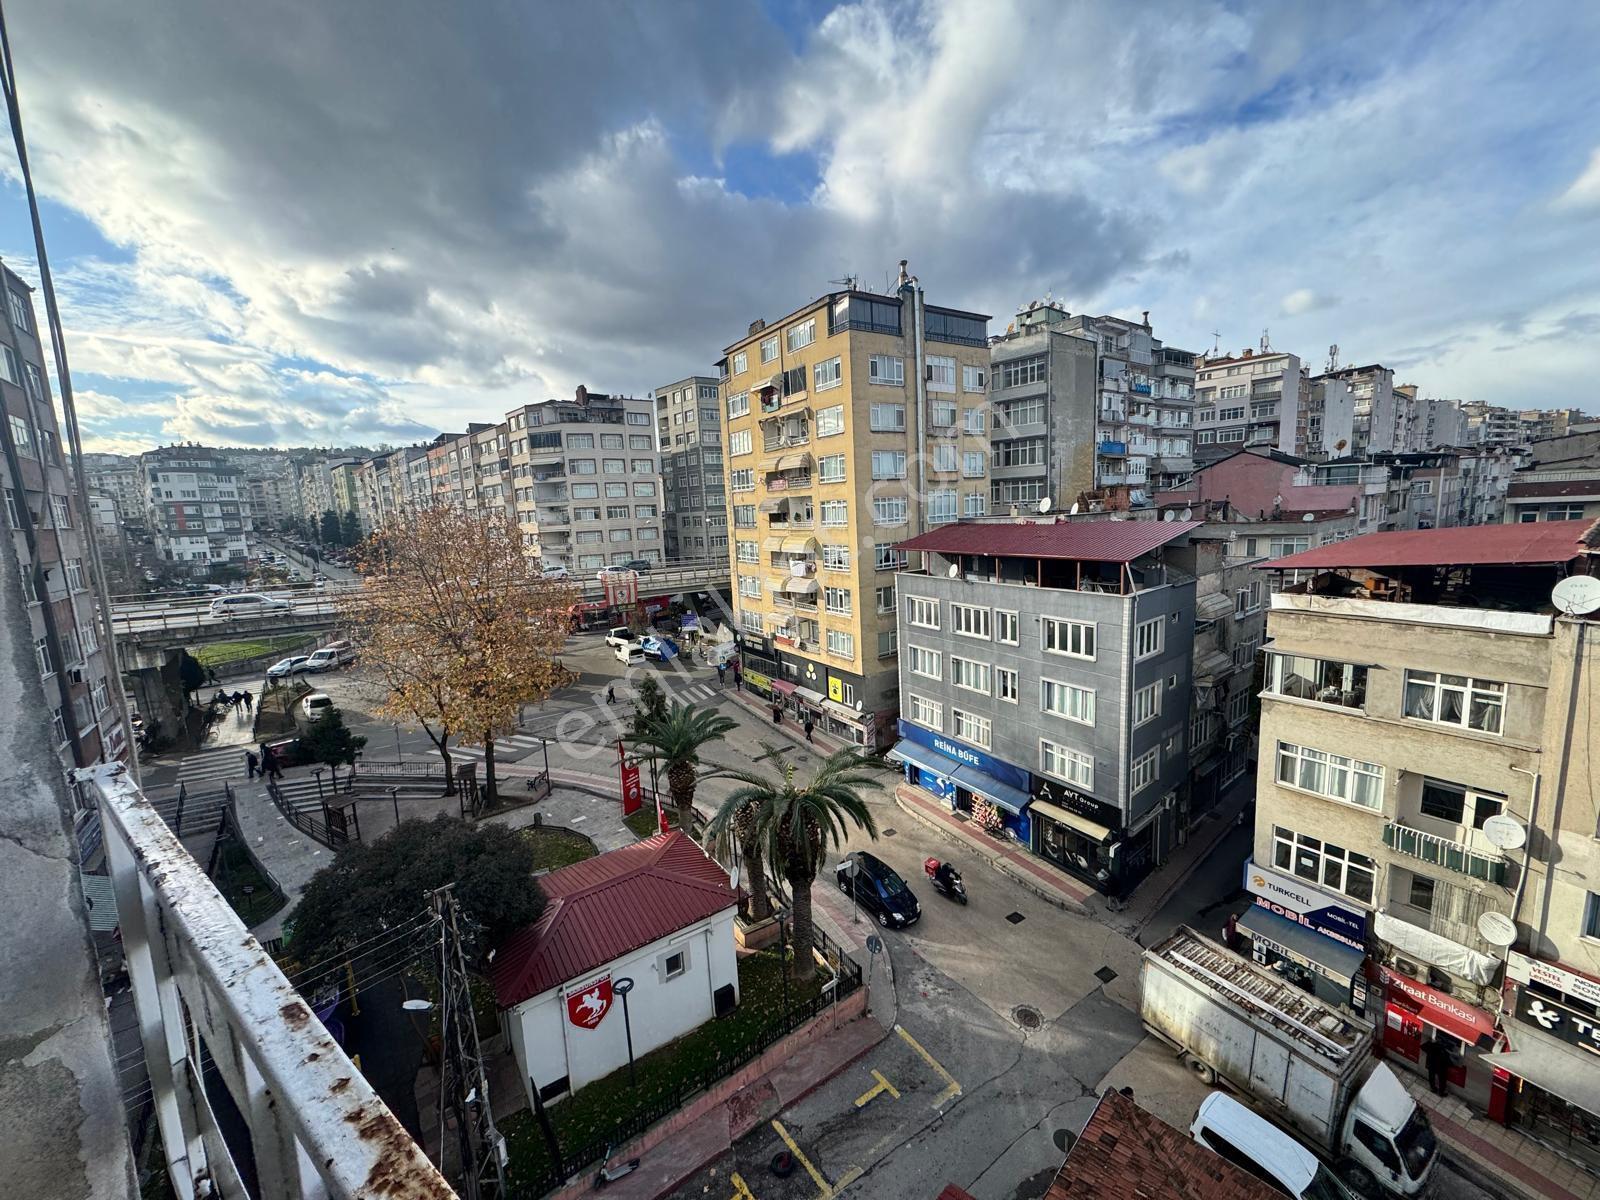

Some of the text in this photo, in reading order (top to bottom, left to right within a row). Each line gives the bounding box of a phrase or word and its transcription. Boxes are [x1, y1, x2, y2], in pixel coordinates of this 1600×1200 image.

[934, 739, 980, 765] REİNA BÜFE
[1063, 789, 1079, 800] AYT
[1267, 882, 1312, 907] TURKCELL
[1428, 993, 1476, 1024] Bankası
